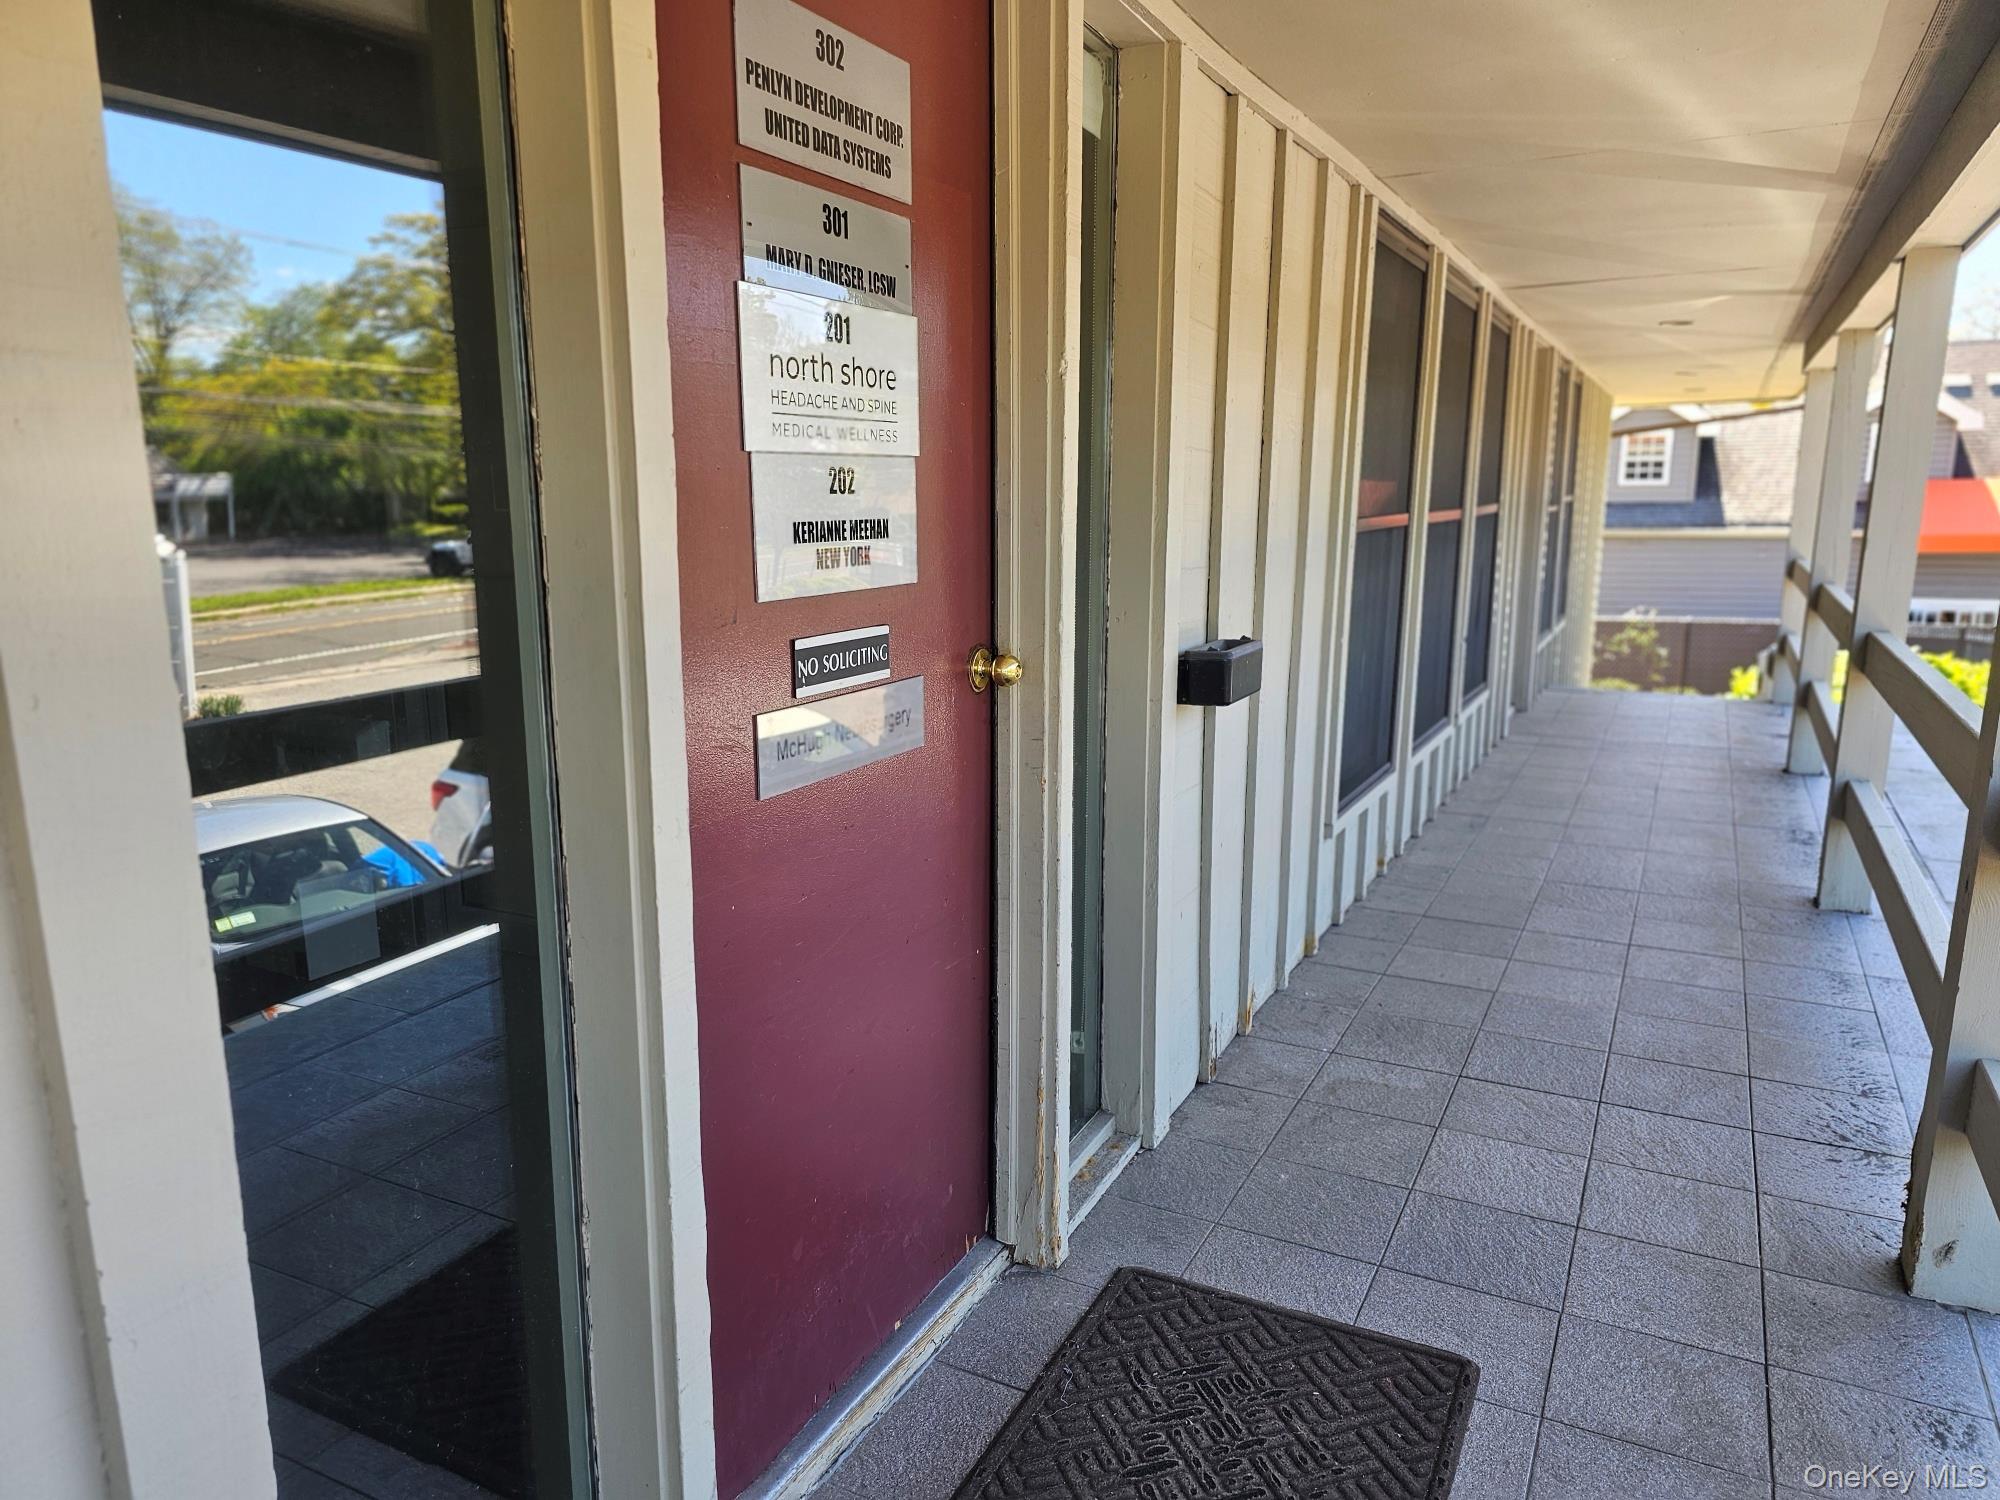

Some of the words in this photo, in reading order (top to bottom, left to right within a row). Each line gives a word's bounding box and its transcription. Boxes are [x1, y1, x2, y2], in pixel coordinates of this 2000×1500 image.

[816, 29, 845, 71] 302
[745, 58, 792, 102] PENLYN
[795, 79, 874, 136] DEVELOPMENT
[876, 115, 904, 149] CORP.
[764, 107, 810, 149] UNITED
[812, 126, 841, 161] DATA
[843, 138, 892, 179] SYSTEMS
[822, 203, 849, 240] 301
[765, 244, 802, 276] MARY
[818, 257, 867, 294] GNIESER,
[868, 270, 897, 298] LCSW
[824, 311, 851, 345] 201
[770, 352, 834, 384] north
[841, 356, 897, 390] shore
[771, 389, 838, 410] HEADACHE
[841, 396, 865, 412] AND
[867, 399, 897, 415] SPINE
[771, 422, 831, 440] MEDICAL
[836, 426, 898, 443] WELLNESS
[828, 466, 855, 495] 202
[792, 520, 847, 544] KERIANNE
[849, 518, 889, 541] MEEHAN
[816, 547, 841, 570] NEW
[844, 545, 871, 567] YORK
[797, 657, 819, 678] NO
[823, 643, 888, 673] SOLICITING
